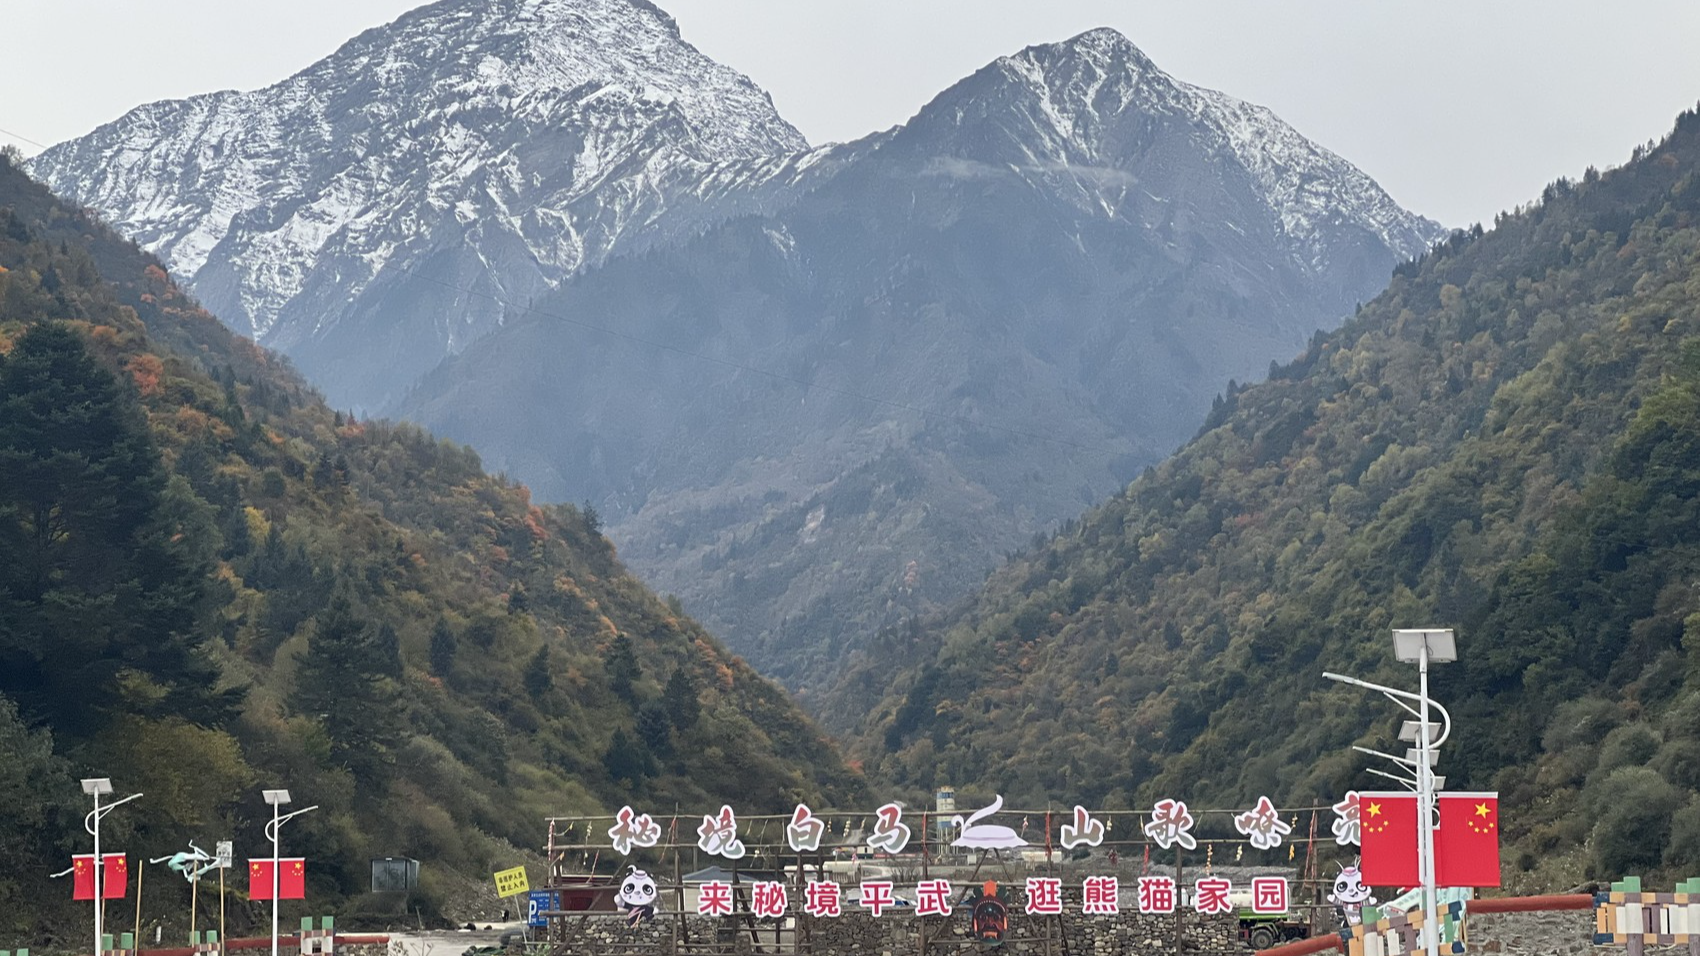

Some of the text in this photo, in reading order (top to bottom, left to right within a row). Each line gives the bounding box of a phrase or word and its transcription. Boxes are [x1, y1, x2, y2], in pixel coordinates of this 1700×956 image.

[608, 804, 911, 858] 秘境白马
[528, 900, 537, 924] P
[698, 877, 1290, 917] 来秘境平武 逛熊猫家园
